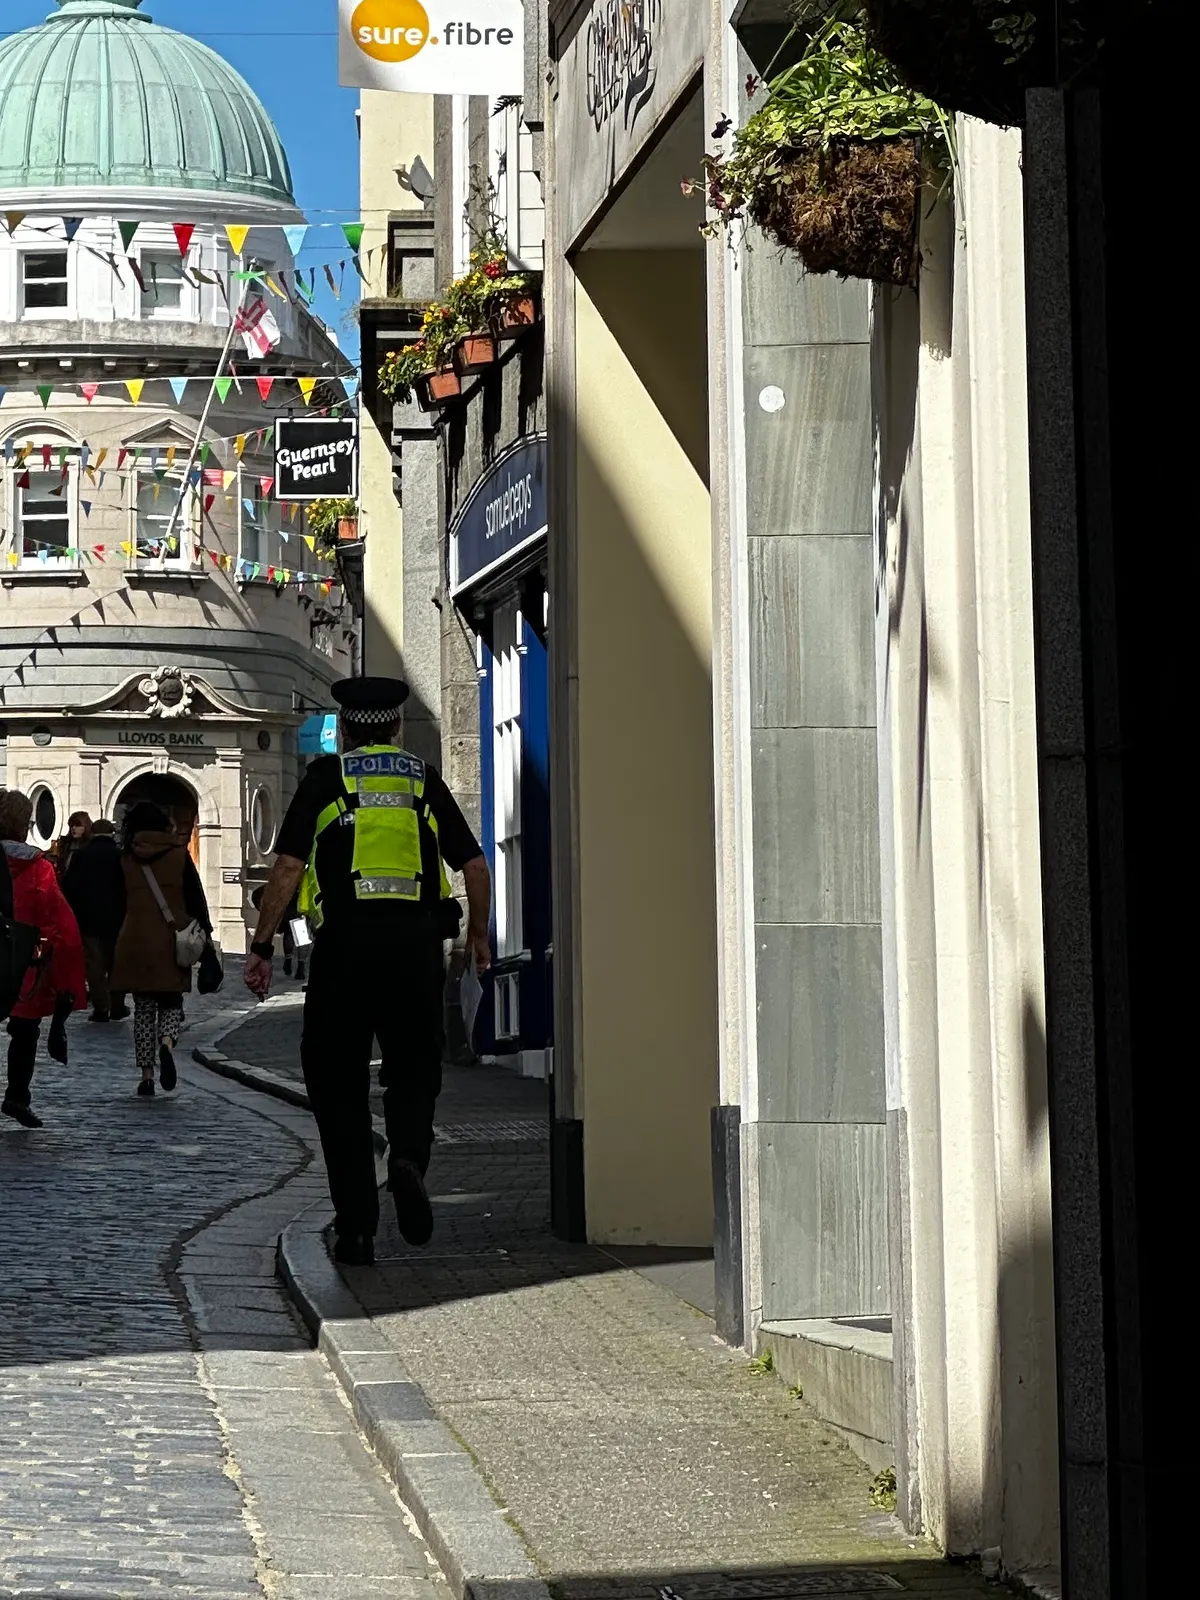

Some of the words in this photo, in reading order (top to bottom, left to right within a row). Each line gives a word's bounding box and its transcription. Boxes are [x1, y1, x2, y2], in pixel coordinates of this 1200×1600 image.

[276, 438, 355, 468] Guernsey
[291, 456, 336, 481] Pearl
[117, 731, 166, 744] LLOYDS
[168, 733, 204, 745] BANK
[347, 756, 423, 777] POLICE
